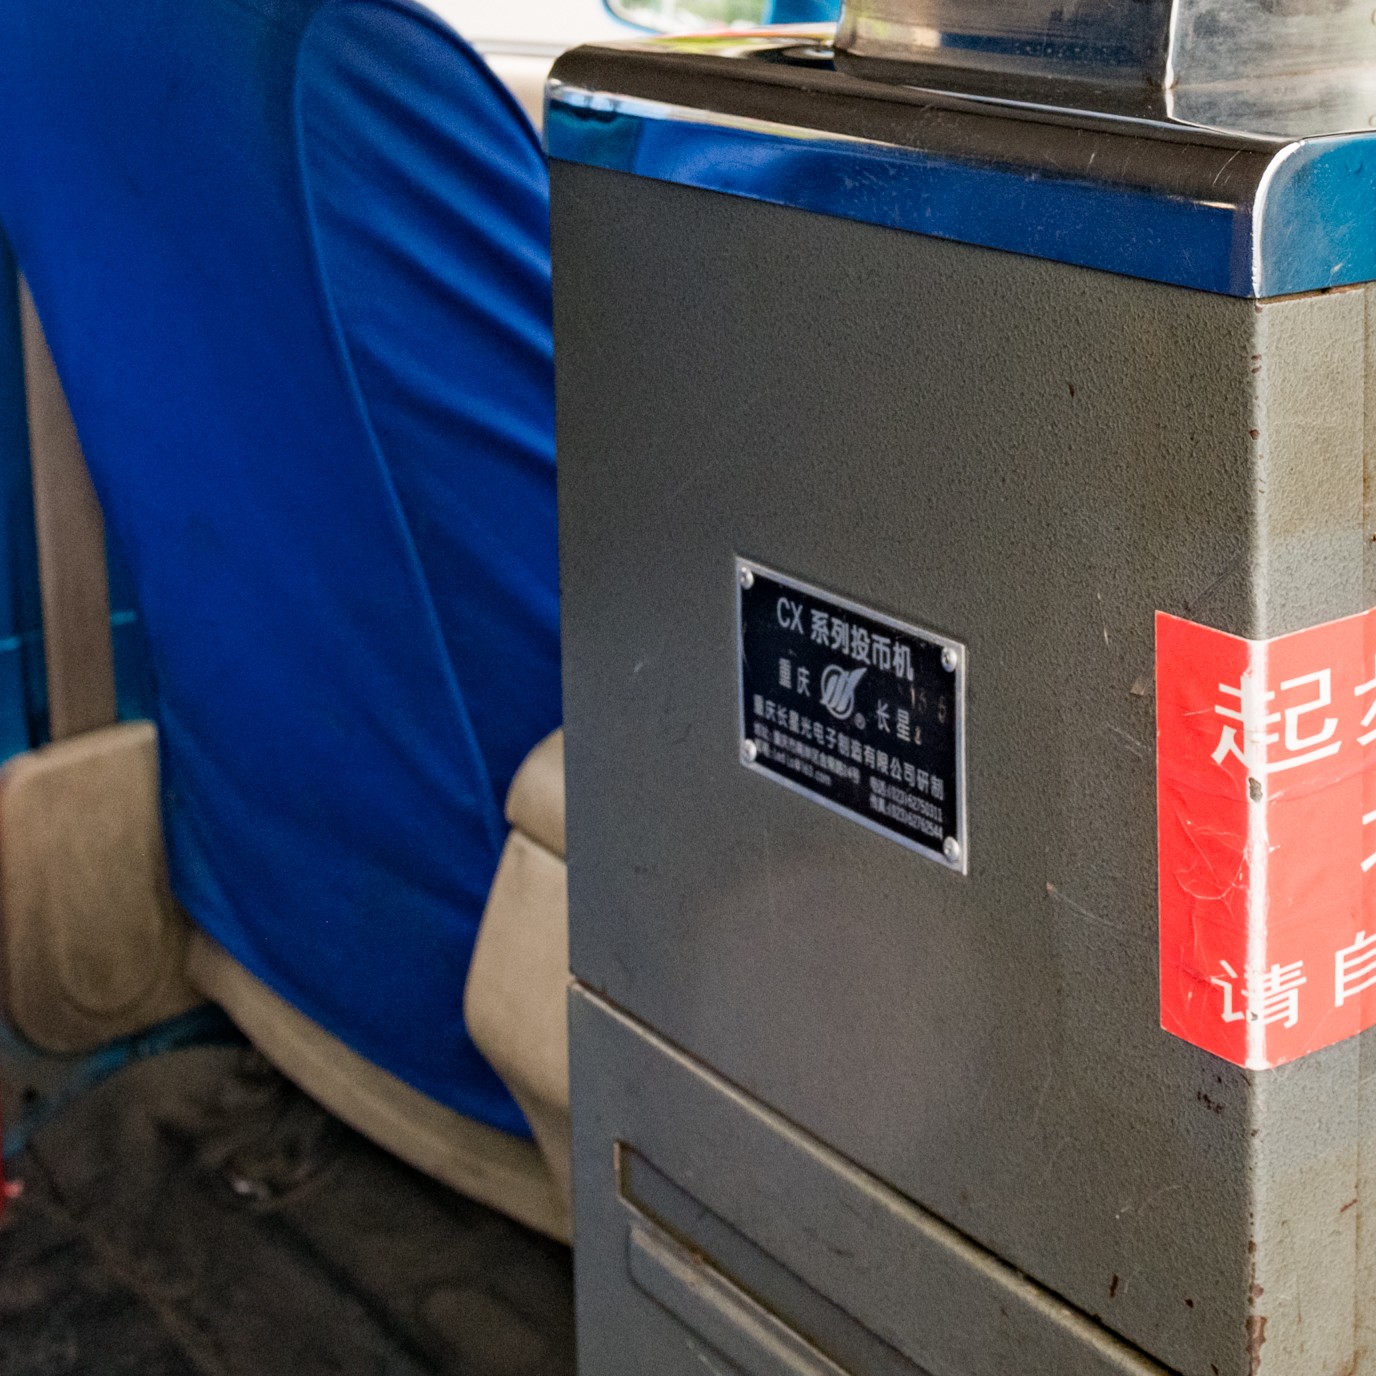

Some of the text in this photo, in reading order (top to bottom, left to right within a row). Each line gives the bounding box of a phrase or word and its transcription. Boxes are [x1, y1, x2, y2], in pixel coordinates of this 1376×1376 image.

[777, 597, 914, 681] CX 系列投币机
[778, 657, 810, 697] 重庆
[877, 699, 911, 742] 长星
